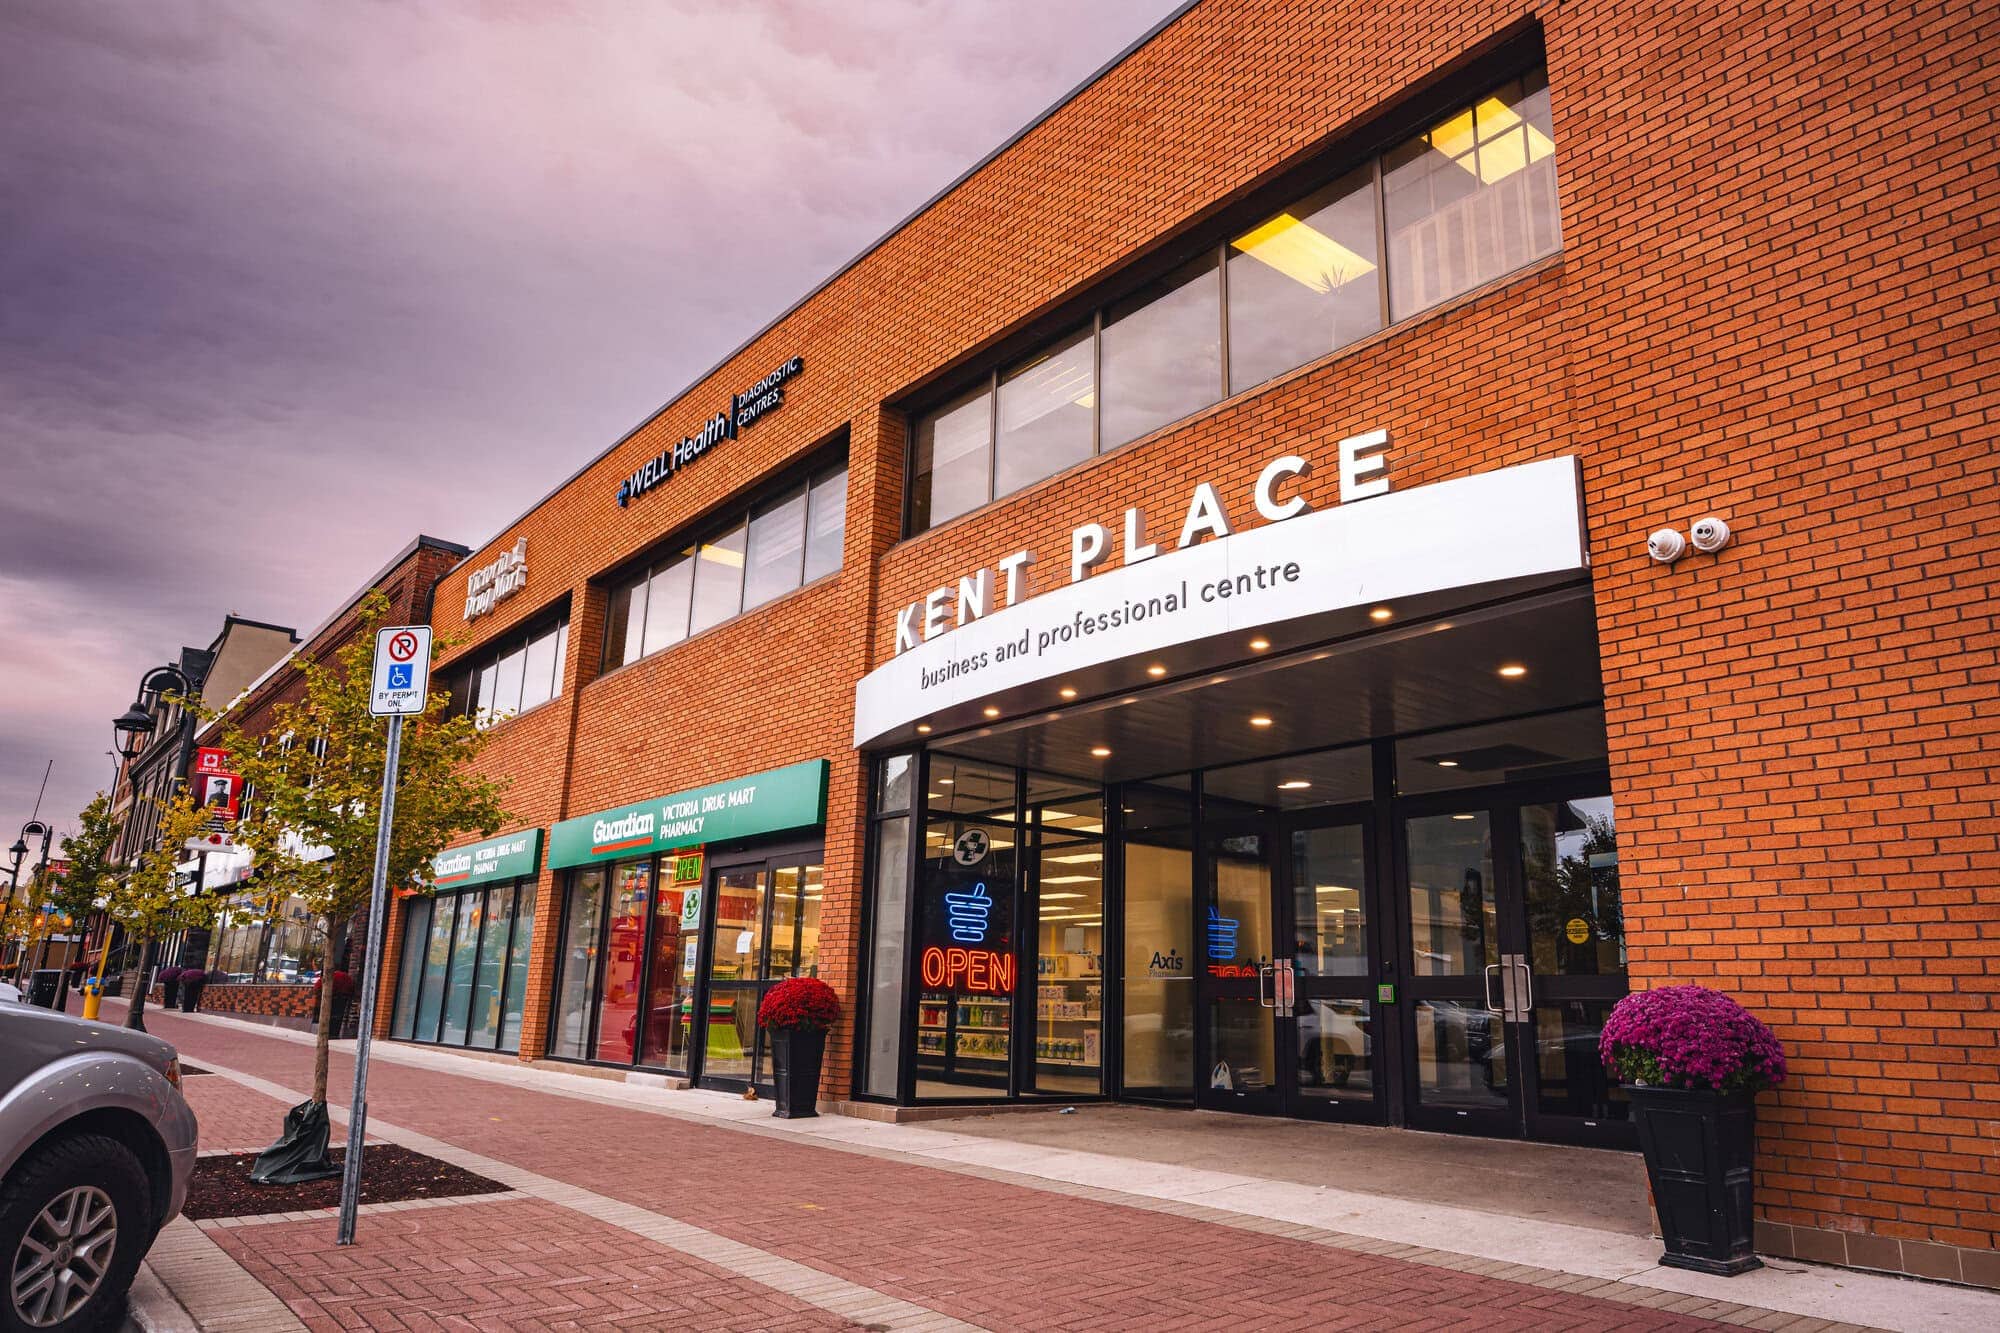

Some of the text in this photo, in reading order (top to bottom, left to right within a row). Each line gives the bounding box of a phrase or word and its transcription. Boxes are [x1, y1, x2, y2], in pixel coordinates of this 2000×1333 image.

[738, 356, 798, 408] DIAGNOSTIC
[737, 388, 779, 426] CENTRES
[630, 412, 726, 497] WELL Health
[895, 428, 1392, 656] KENT PLACE
[463, 564, 528, 620] Drug Mart
[921, 561, 1300, 690] business and professional centre
[378, 692, 389, 700] BY
[387, 699, 405, 708] ONL
[662, 786, 756, 821] VICTORIA DRUG MART
[593, 811, 655, 844] Guardian
[660, 817, 704, 840] PHARMACY
[511, 839, 527, 854] MART
[435, 853, 471, 877] Guardian
[675, 857, 701, 881] OPEN
[922, 946, 1012, 992] OPEN
[1149, 948, 1184, 970] Axis
